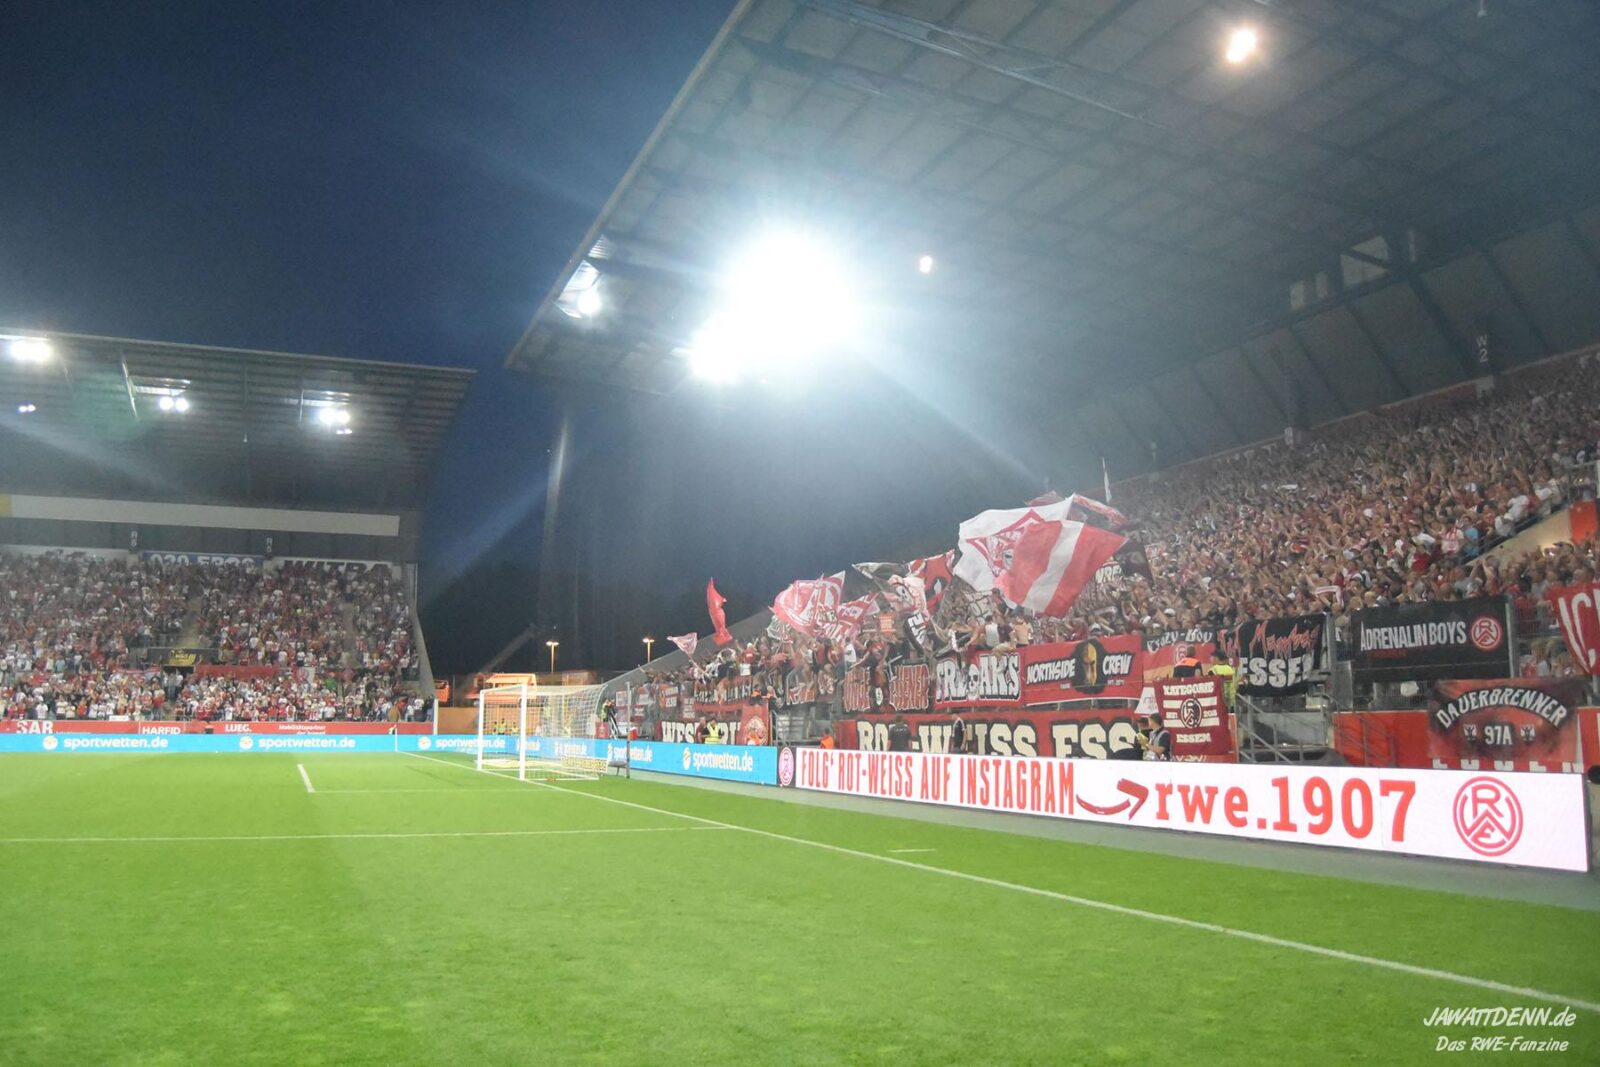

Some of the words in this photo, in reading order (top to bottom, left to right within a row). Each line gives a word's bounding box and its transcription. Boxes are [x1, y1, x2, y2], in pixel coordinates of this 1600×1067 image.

[1361, 620, 1428, 651] ADRENALIN
[1430, 621, 1466, 644] BOYS
[1026, 658, 1076, 684] NORTHSIDE
[1102, 654, 1132, 675] CREW
[1436, 688, 1567, 729] DAUERBRENNER
[64, 736, 168, 750] sportwetten.de
[258, 736, 356, 749] sportwetten.de
[1484, 726, 1513, 745] 97A
[693, 750, 753, 771] sportwetten.de
[838, 753, 913, 798] ROT-WEISS
[920, 757, 951, 802] AUF
[959, 757, 1074, 815] INSTAGRAM
[1155, 776, 1416, 843] rwe.1907
